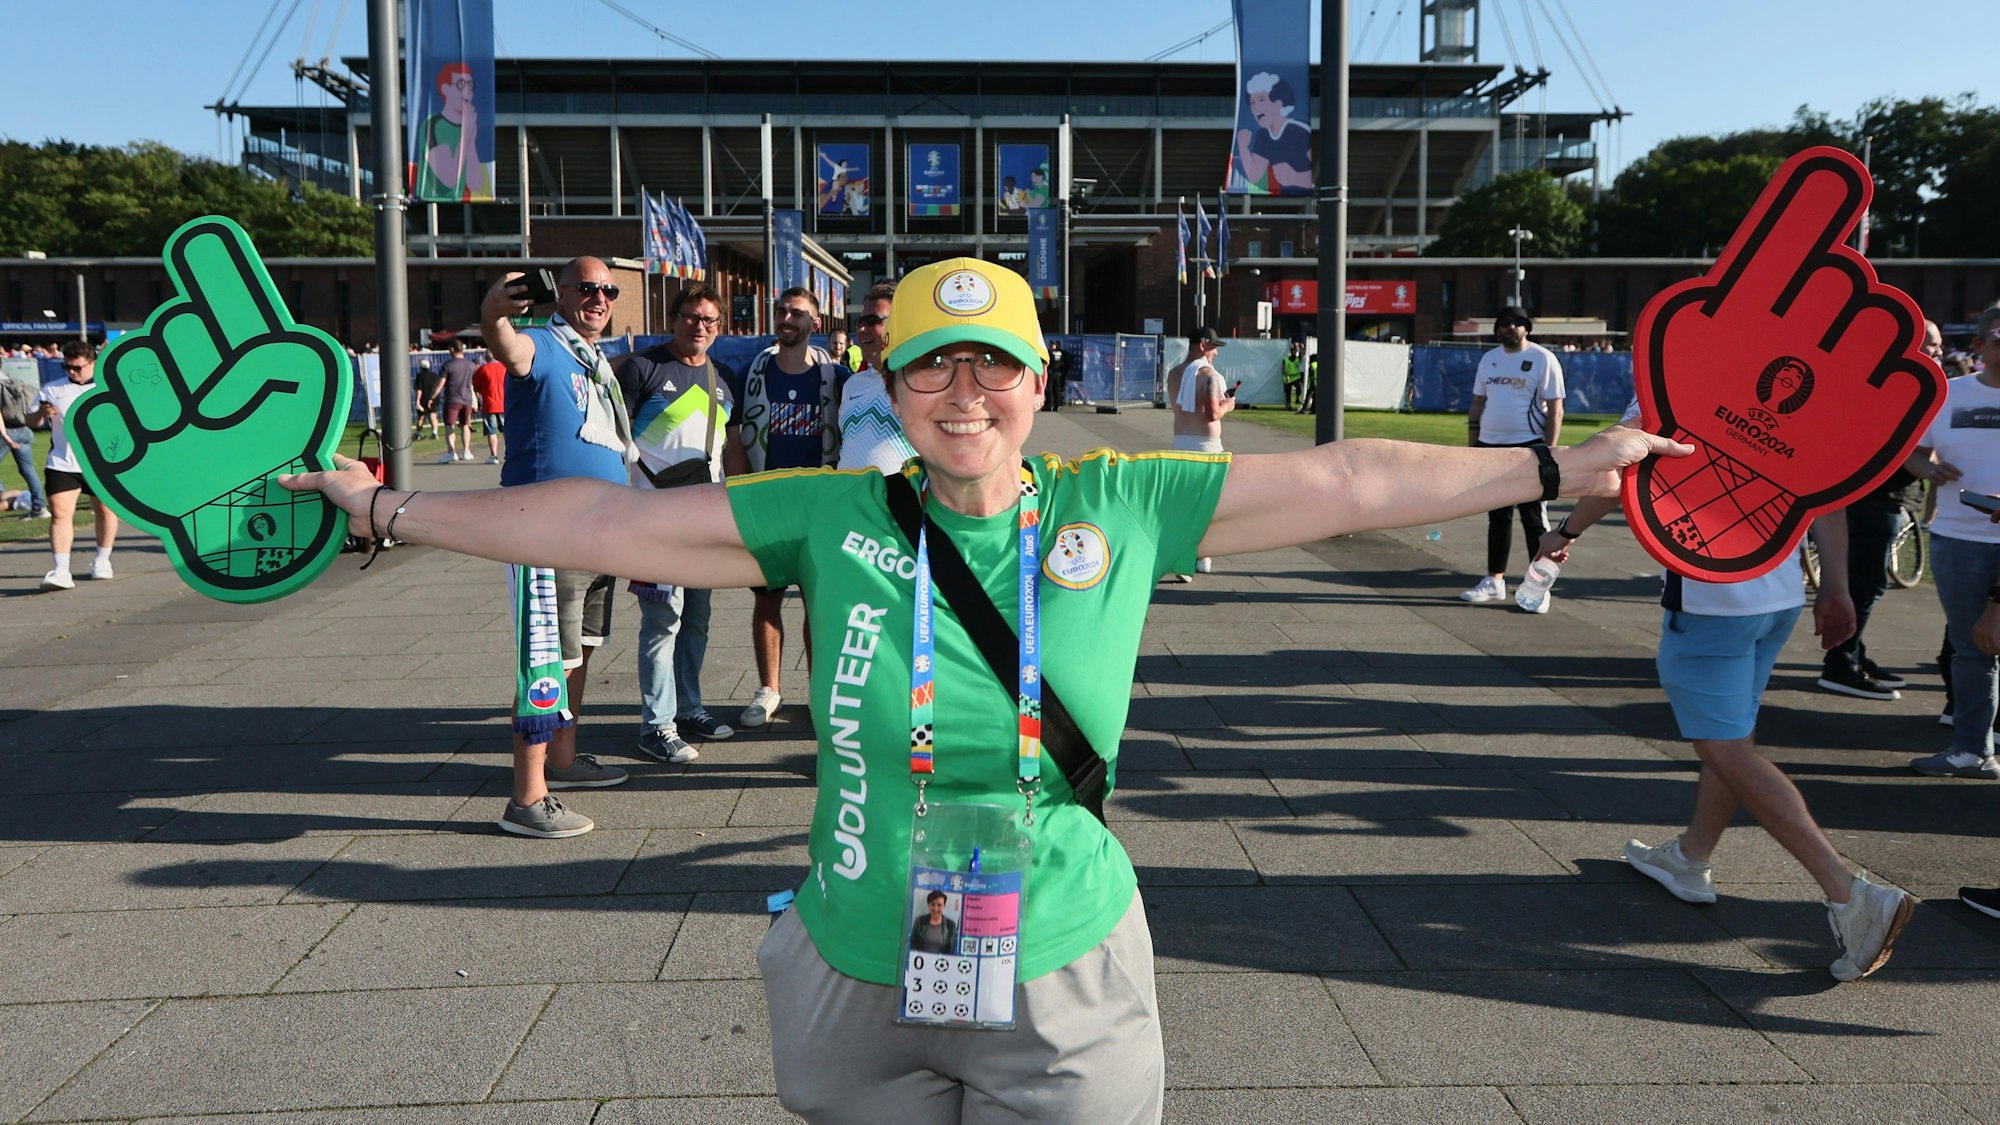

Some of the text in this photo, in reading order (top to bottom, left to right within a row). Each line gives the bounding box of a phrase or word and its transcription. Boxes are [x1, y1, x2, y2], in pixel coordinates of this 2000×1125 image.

[2, 322, 67, 330] OFFICIAL FAN SHOP
[1748, 410, 1776, 431] UEFA
[1714, 404, 1795, 459] EURO2024
[1725, 427, 1770, 457] GERMANY
[841, 530, 918, 580] ERGO
[1062, 560, 1100, 576] EURO2024
[529, 567, 560, 668] LOVENIA
[913, 956, 924, 970] 0
[912, 977, 922, 993] 3
